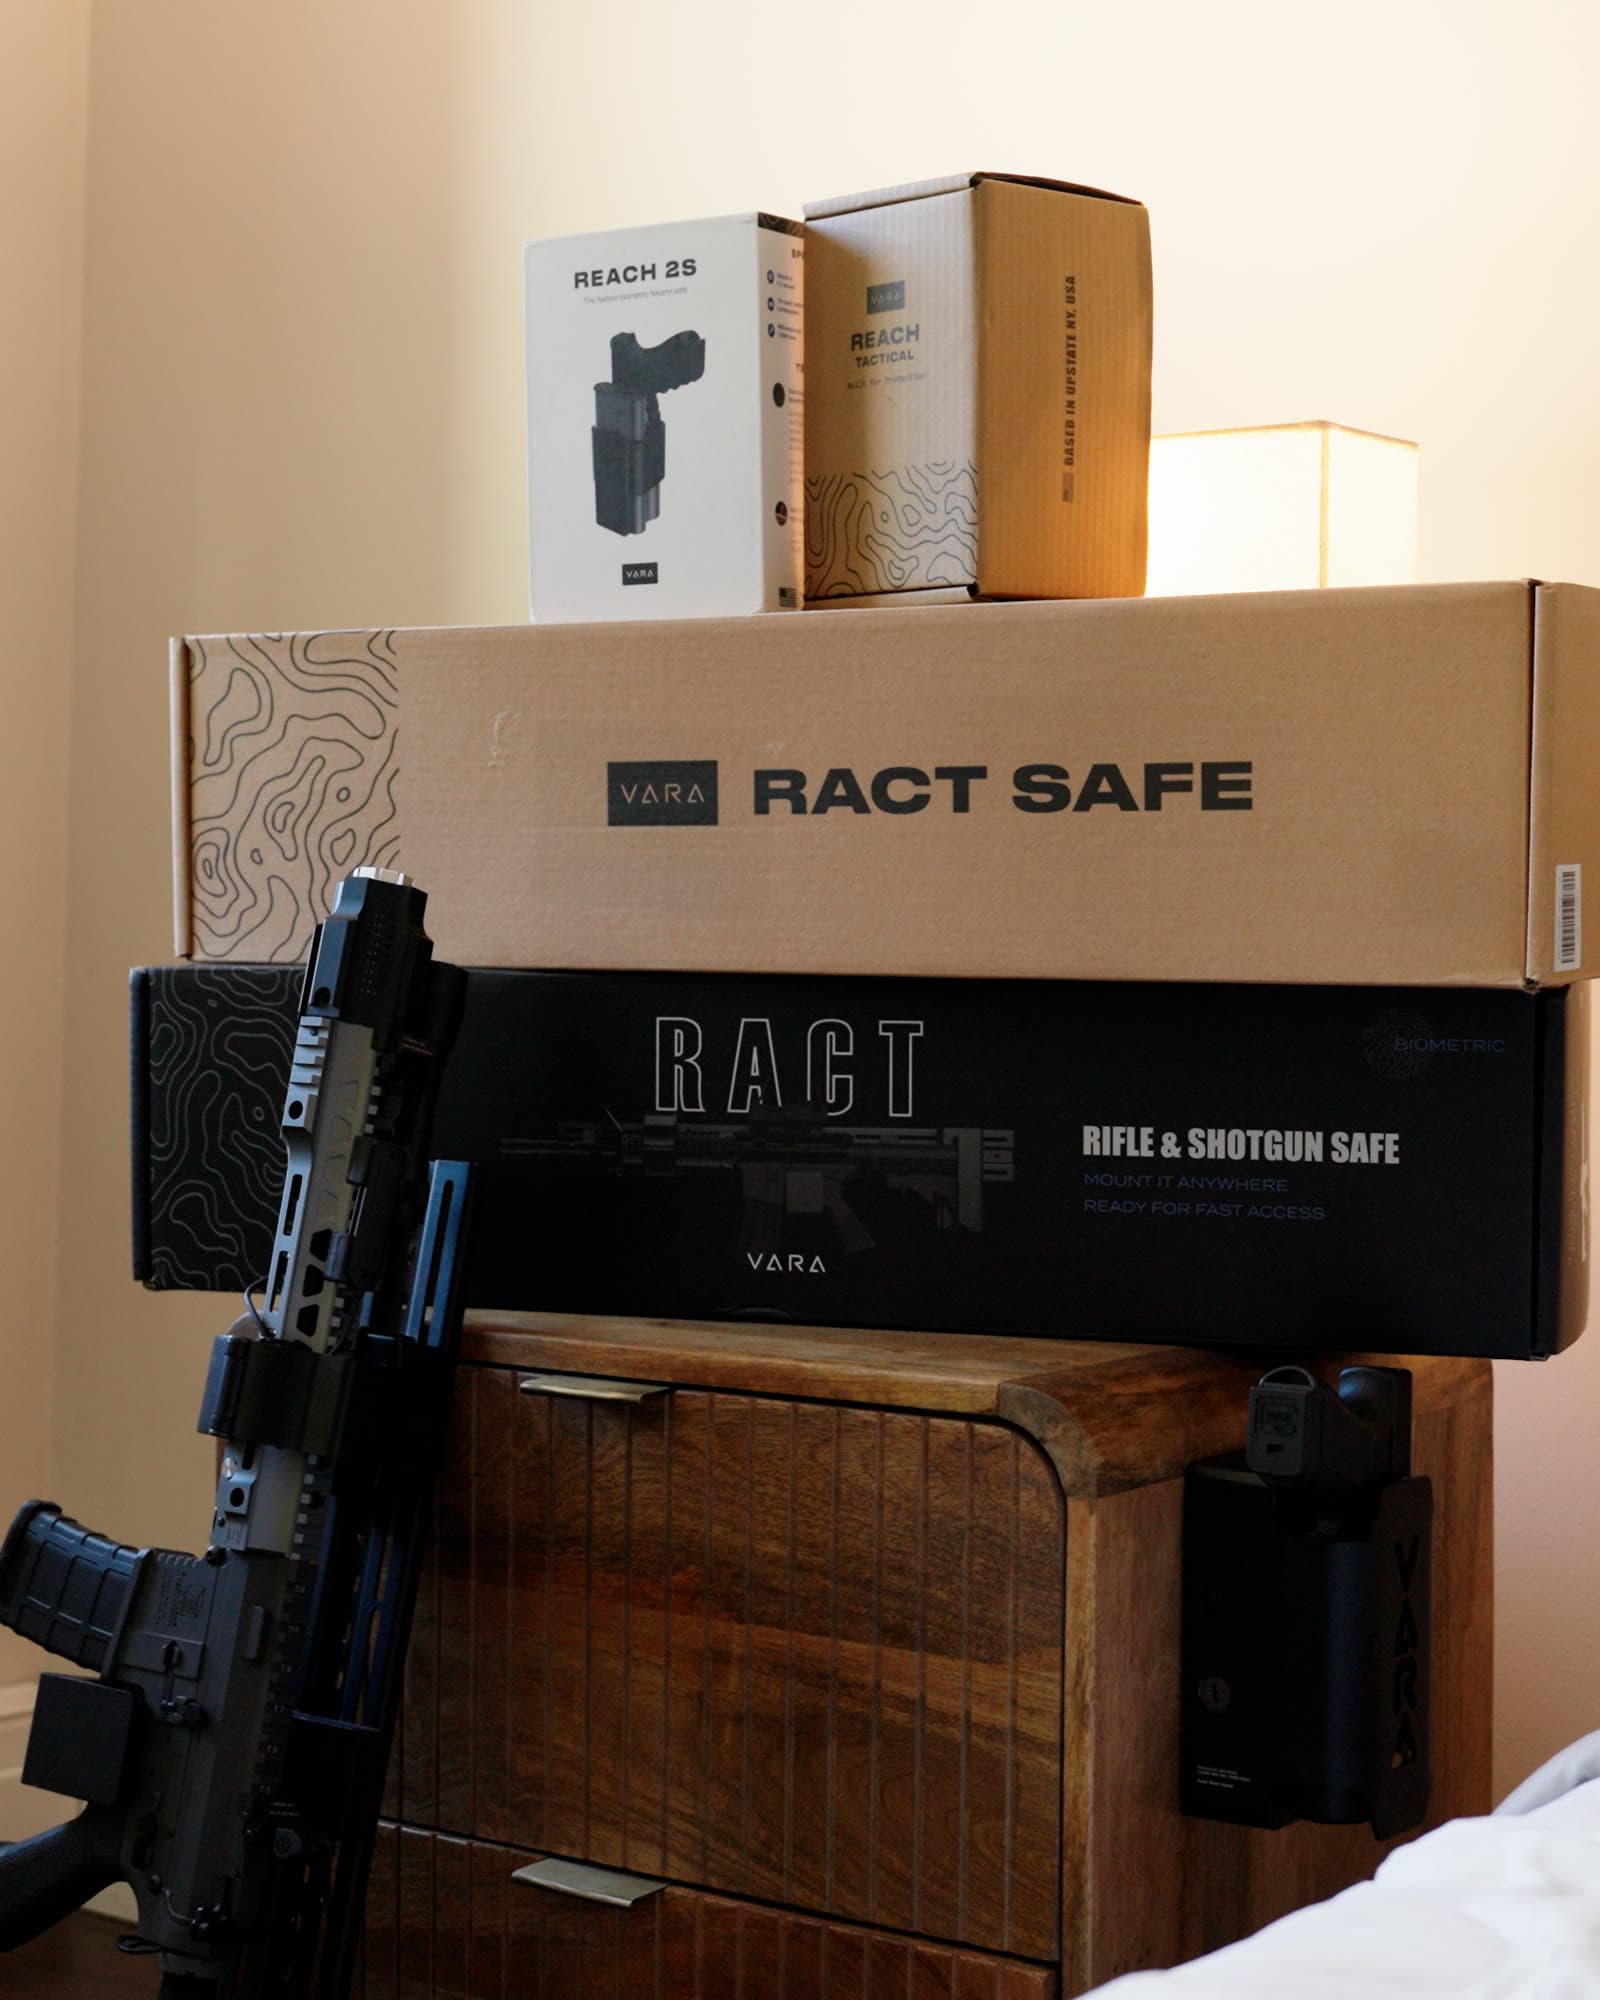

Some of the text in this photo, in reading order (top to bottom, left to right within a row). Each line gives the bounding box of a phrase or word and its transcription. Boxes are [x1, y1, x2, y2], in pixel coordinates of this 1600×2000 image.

[574, 258, 697, 289] REACH 2S
[1065, 275, 1076, 304] USA
[851, 323, 920, 352] REACH
[856, 350, 915, 369] TACTICAL
[1066, 333, 1077, 395] UPSTATE
[1065, 400, 1075, 415] IN
[1064, 419, 1075, 466] BASED
[626, 569, 654, 578] VARA
[620, 762, 1253, 815] VARA RACT SAFE
[1394, 1038, 1506, 1053] BIOMETRIC
[656, 1016, 924, 1117] RACT
[1082, 1125, 1400, 1165] RIFLE & SHOTGUN SAFE
[1084, 1173, 1289, 1192] MOUNT IT ANYWHERE
[1084, 1200, 1326, 1220] READY FOR FAST ACCESS
[748, 1253, 826, 1272] VARA
